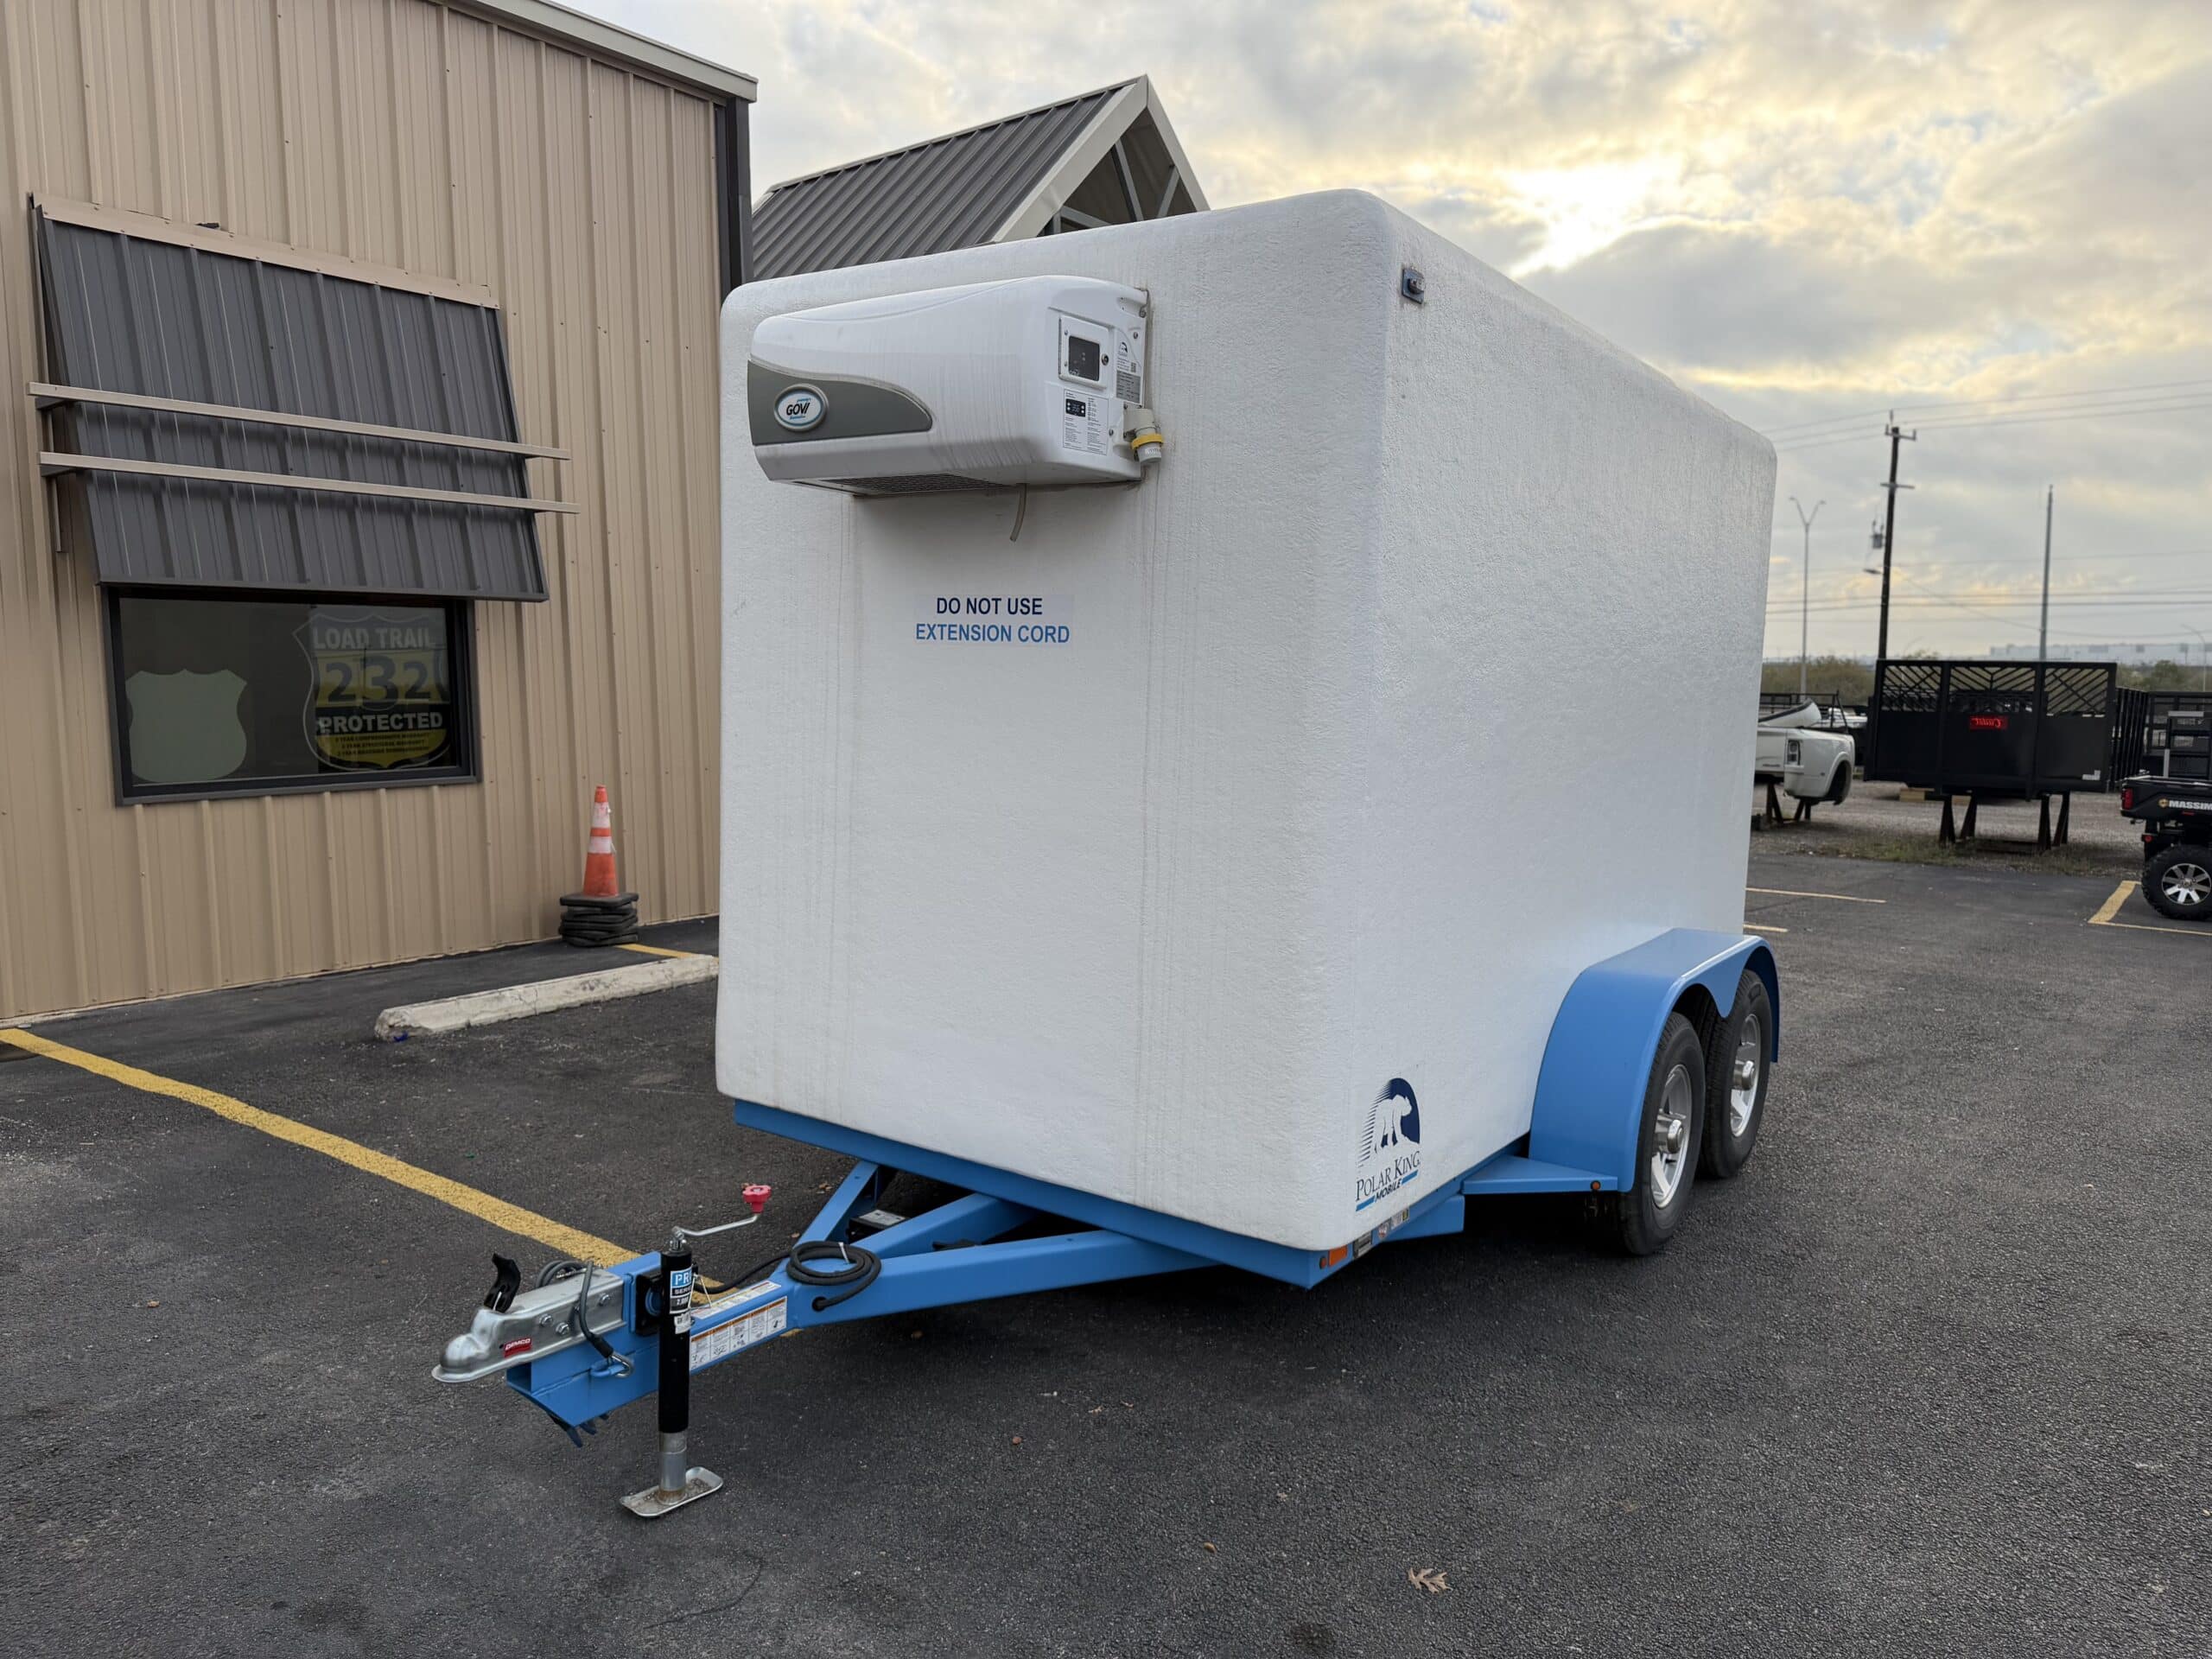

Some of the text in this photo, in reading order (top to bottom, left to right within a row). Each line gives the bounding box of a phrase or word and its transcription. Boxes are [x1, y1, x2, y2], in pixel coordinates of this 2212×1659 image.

[937, 597, 1043, 615] DO NOT USE
[313, 627, 435, 649] LOAD TRAIL
[916, 623, 1071, 644] EXTENSION CORD
[326, 655, 431, 709] 232
[318, 711, 442, 734] PROTECTED
[1356, 1151, 1421, 1202] POLAR KING
[1375, 1178, 1402, 1203] MOBILE
